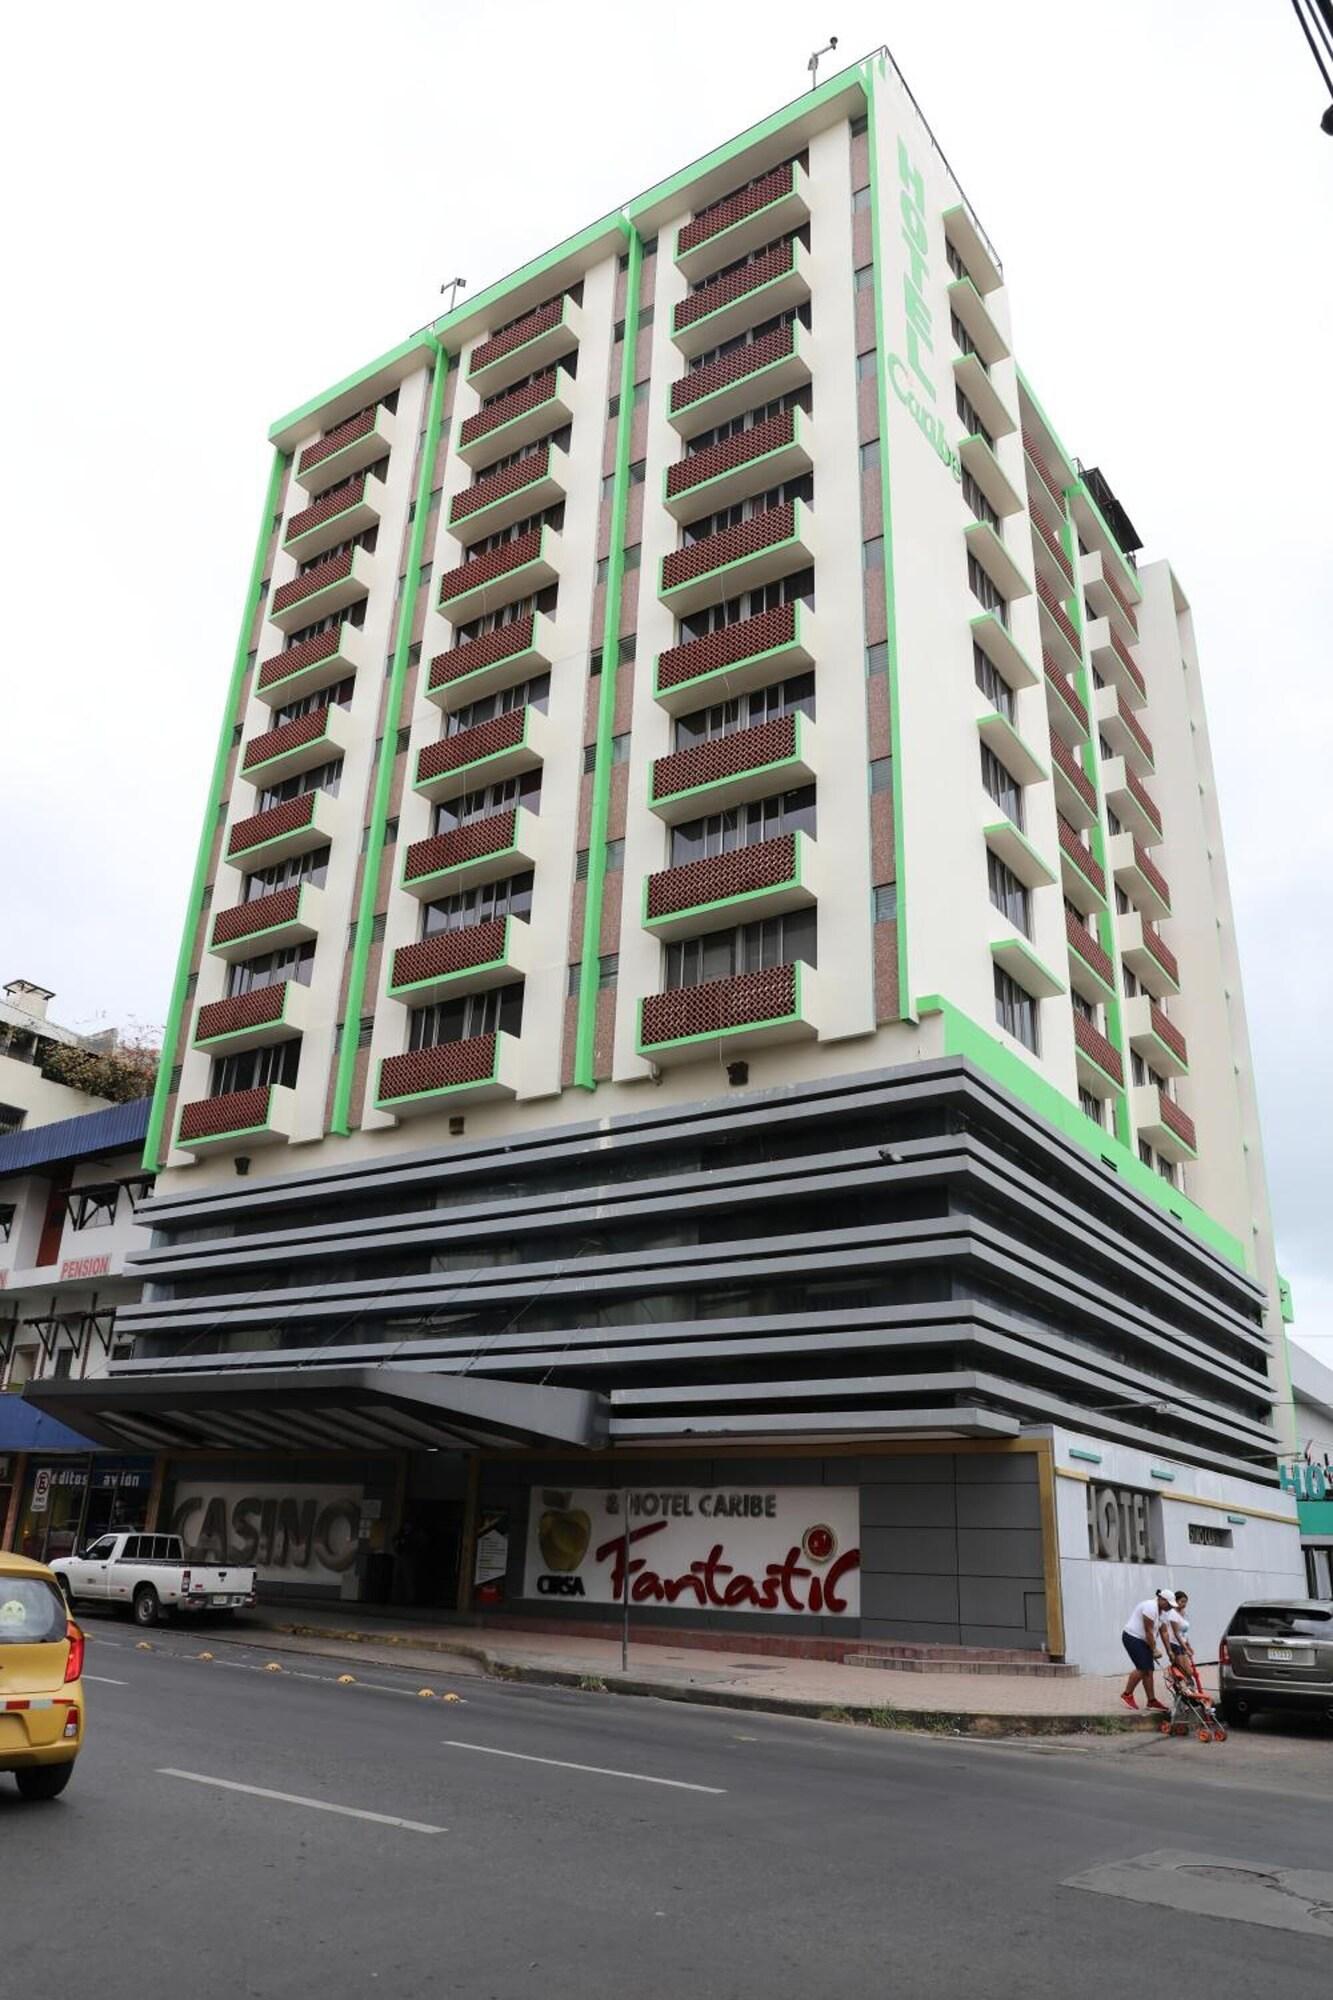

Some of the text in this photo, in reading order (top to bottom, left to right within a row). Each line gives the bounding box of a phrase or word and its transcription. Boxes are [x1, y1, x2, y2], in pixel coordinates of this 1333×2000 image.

[897, 133, 937, 403] HOTEL
[887, 352, 961, 484] Caribe
[61, 1256, 110, 1280] PENSION
[171, 1496, 361, 1573] CASINO
[629, 1493, 694, 1517] HOTEL
[698, 1494, 777, 1518] CARIBE
[596, 1519, 861, 1613] Fantastic
